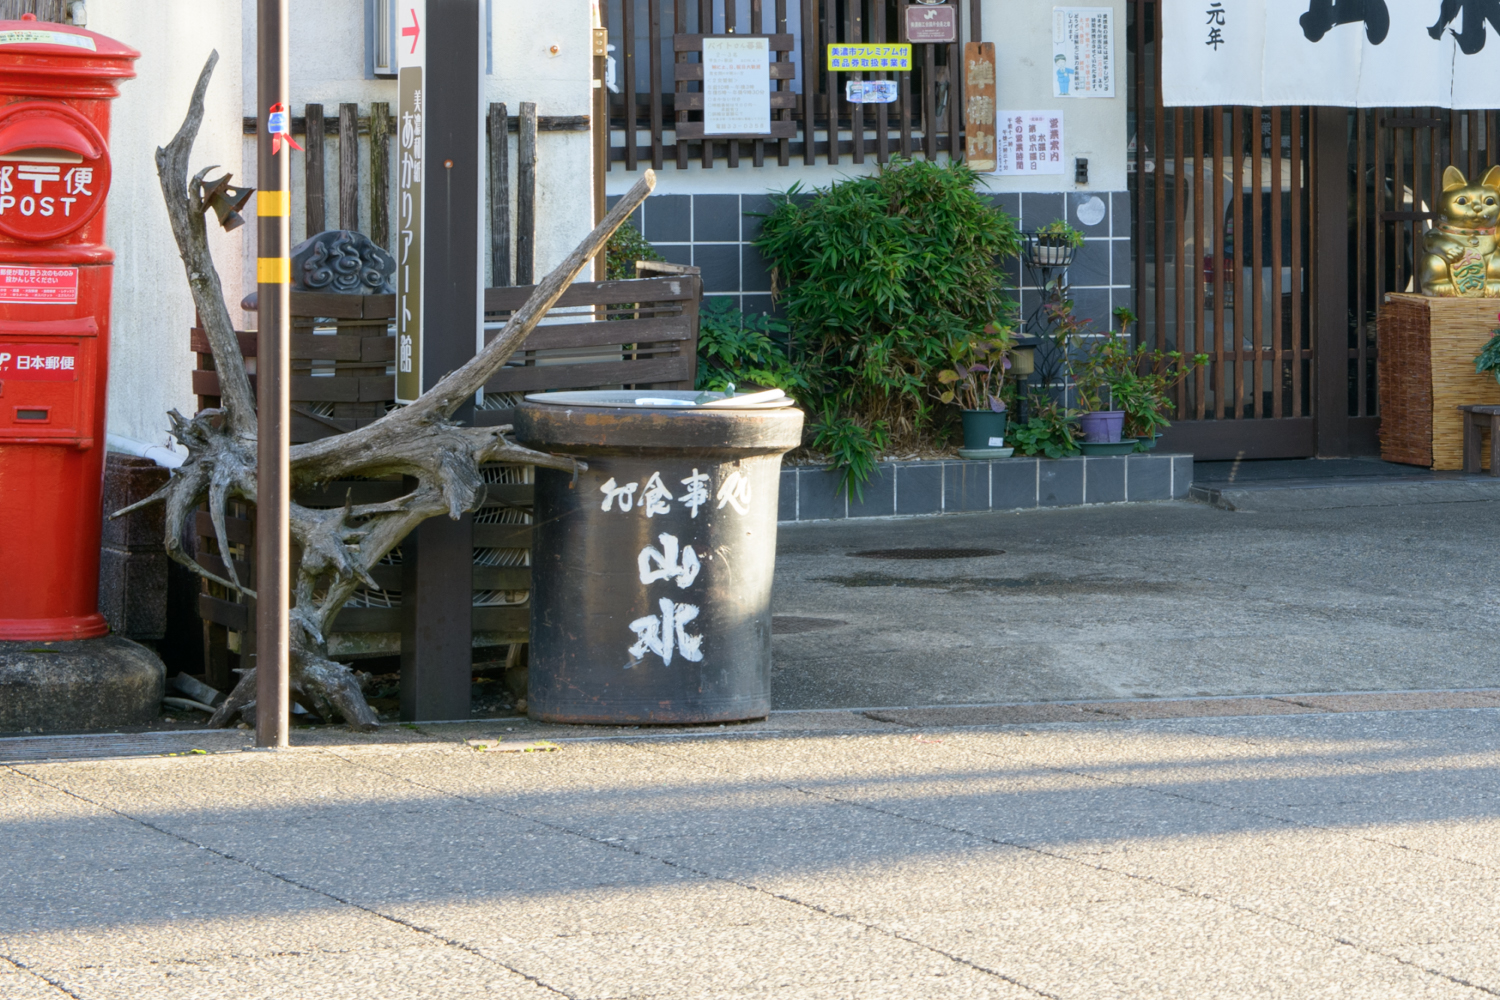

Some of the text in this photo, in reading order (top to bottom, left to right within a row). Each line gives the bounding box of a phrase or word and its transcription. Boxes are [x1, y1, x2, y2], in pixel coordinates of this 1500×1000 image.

[832, 47, 907, 56] 美濃市プレミアム付
[832, 59, 907, 67] 商品券取扱事業者
[1015, 116, 1024, 170] 冬の営業時間
[1049, 118, 1060, 162] 営業案内
[0, 195, 77, 217] POST
[401, 111, 413, 372] あかりアート館
[16, 355, 75, 371] 日本郵便
[601, 470, 753, 519] お食事処
[630, 534, 703, 666] 山水
